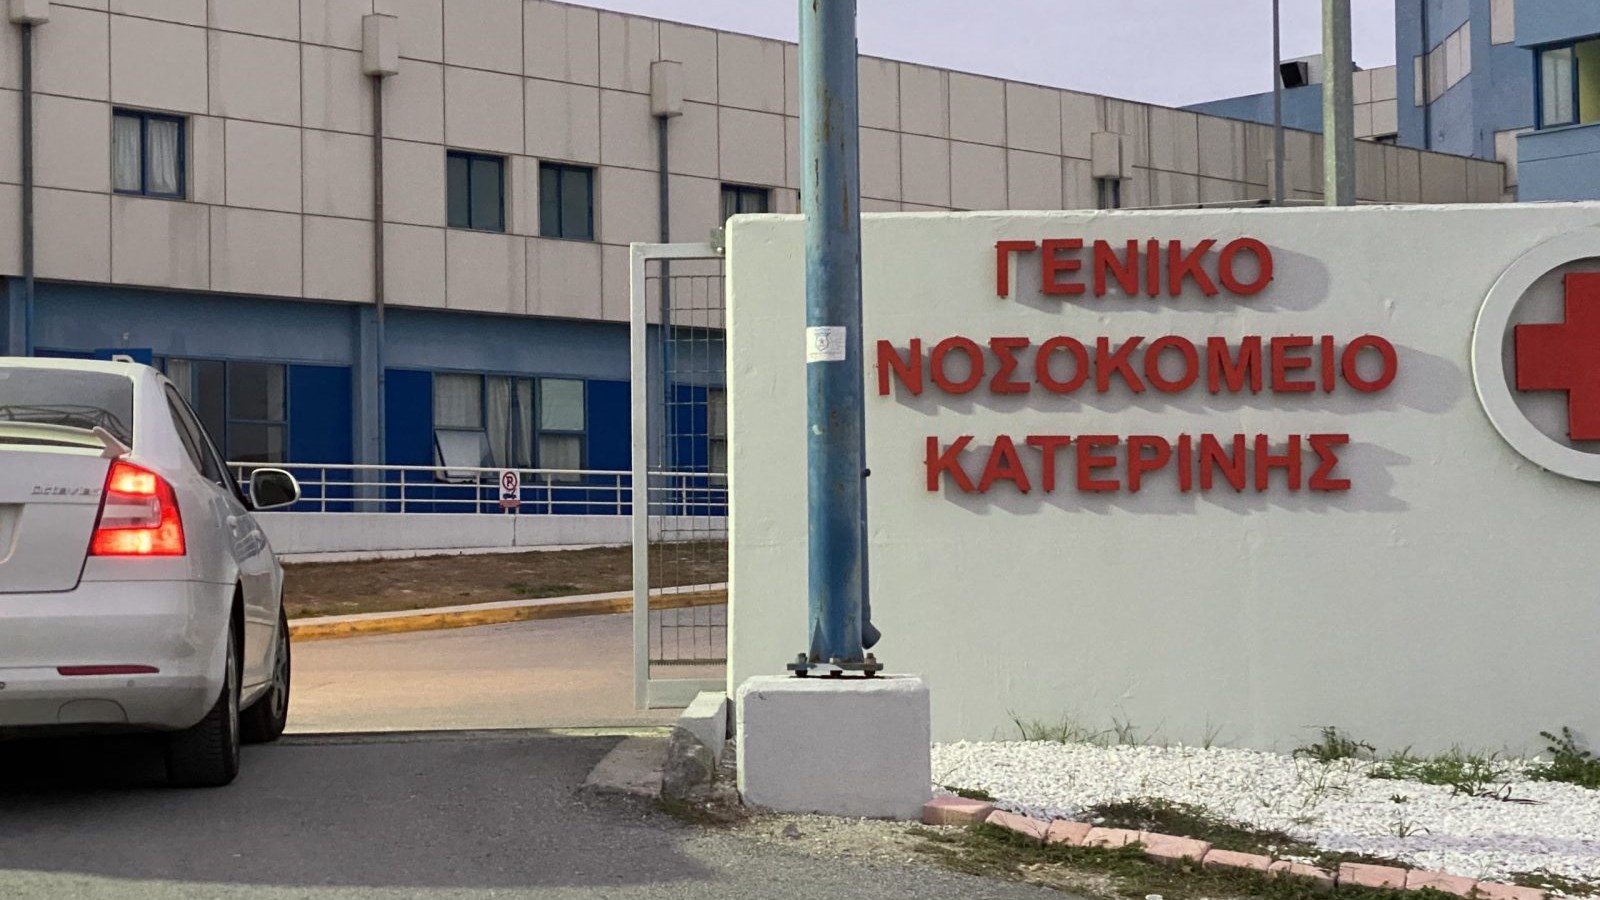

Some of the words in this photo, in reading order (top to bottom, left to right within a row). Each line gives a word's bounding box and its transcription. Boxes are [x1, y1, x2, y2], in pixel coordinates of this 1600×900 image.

[996, 238, 1273, 296] ΓΕΝΙΚΟ
[877, 335, 1398, 396] ΝΟΣΟΚΟΜΕΙΟ
[926, 433, 1351, 493] ΚΑΤΕΡΙΝΗΣ
